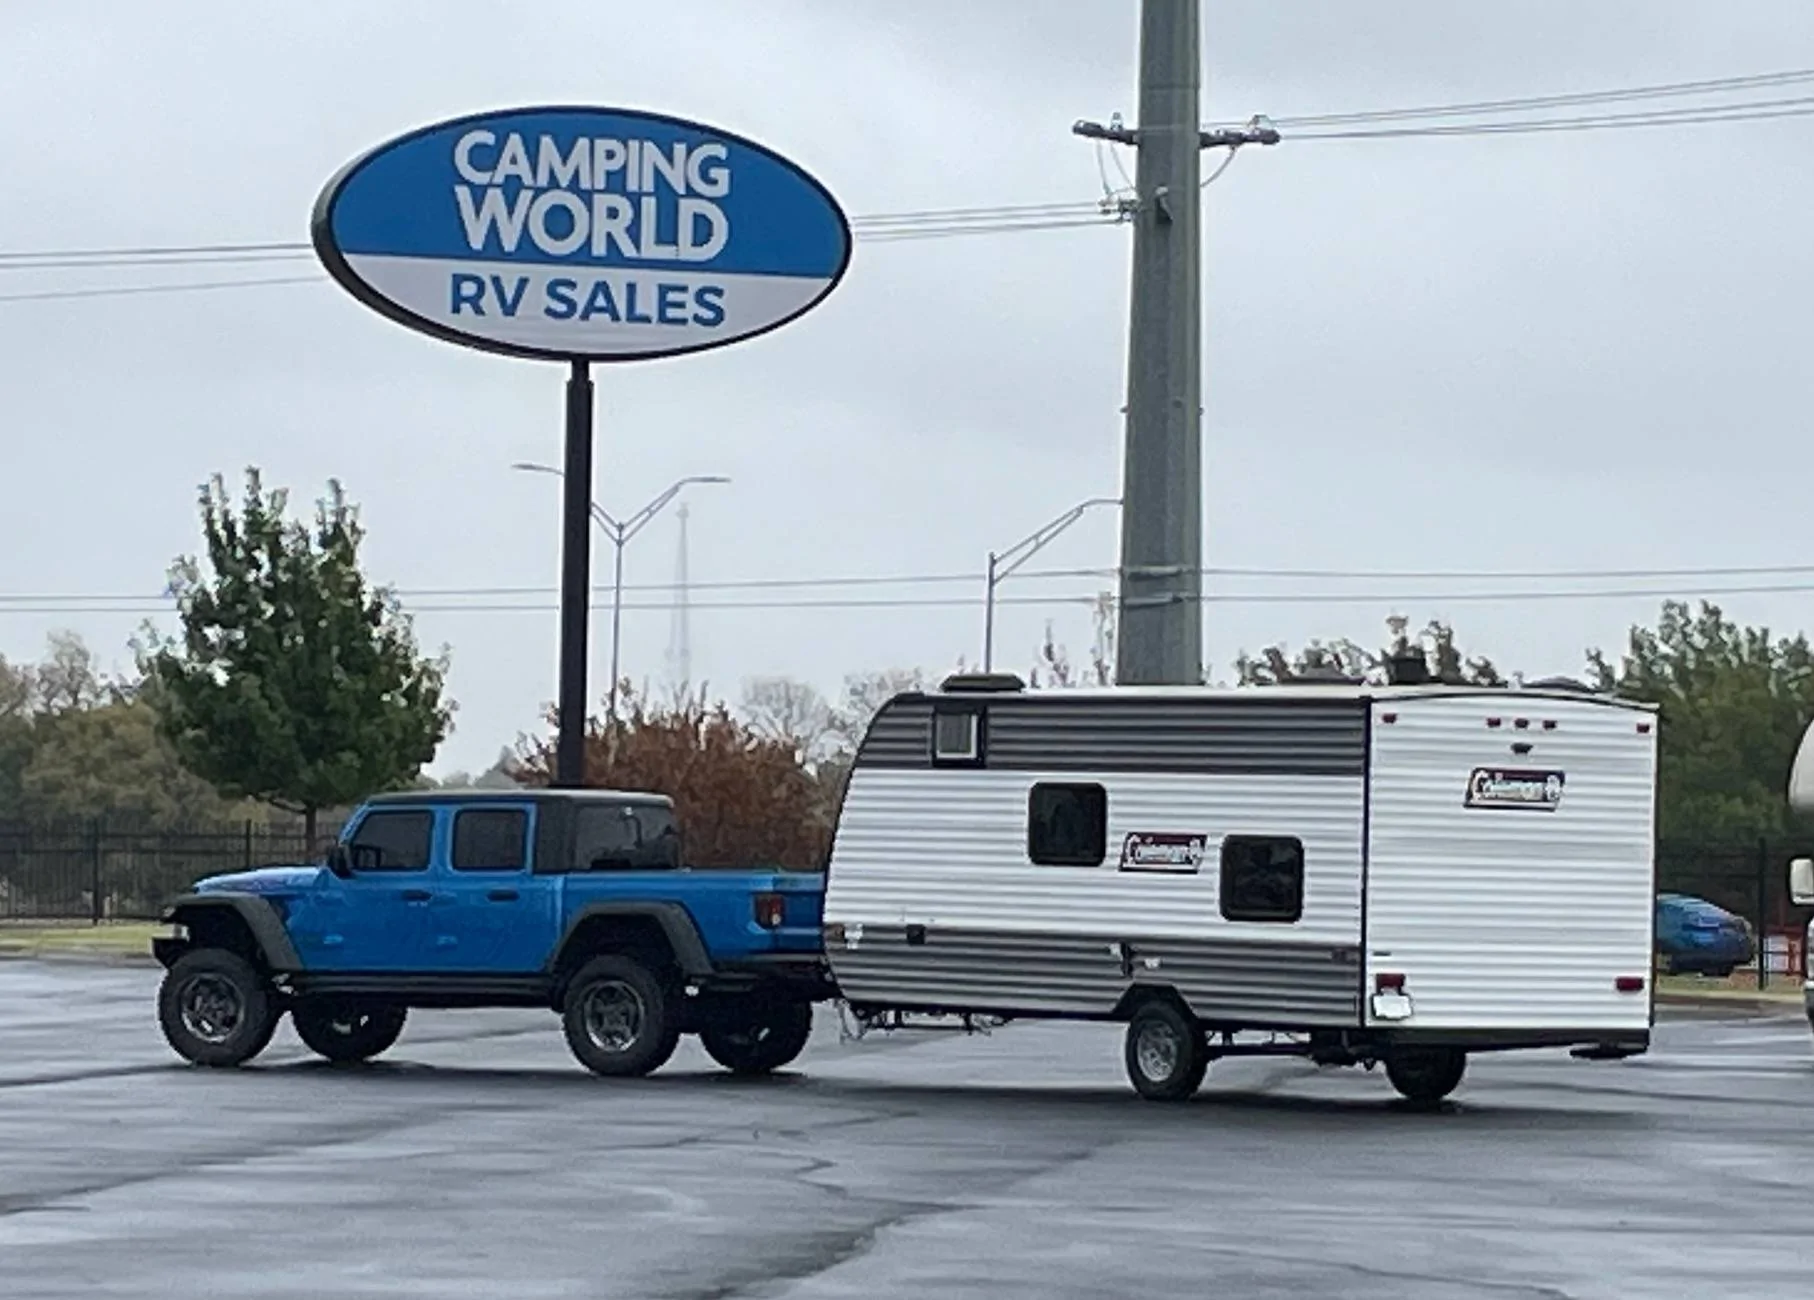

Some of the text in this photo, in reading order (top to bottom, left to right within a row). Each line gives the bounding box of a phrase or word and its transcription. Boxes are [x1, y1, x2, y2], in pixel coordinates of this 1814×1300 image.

[454, 130, 730, 197] CAMPING
[454, 185, 730, 261] WORLD
[449, 272, 726, 329] RV SALES
